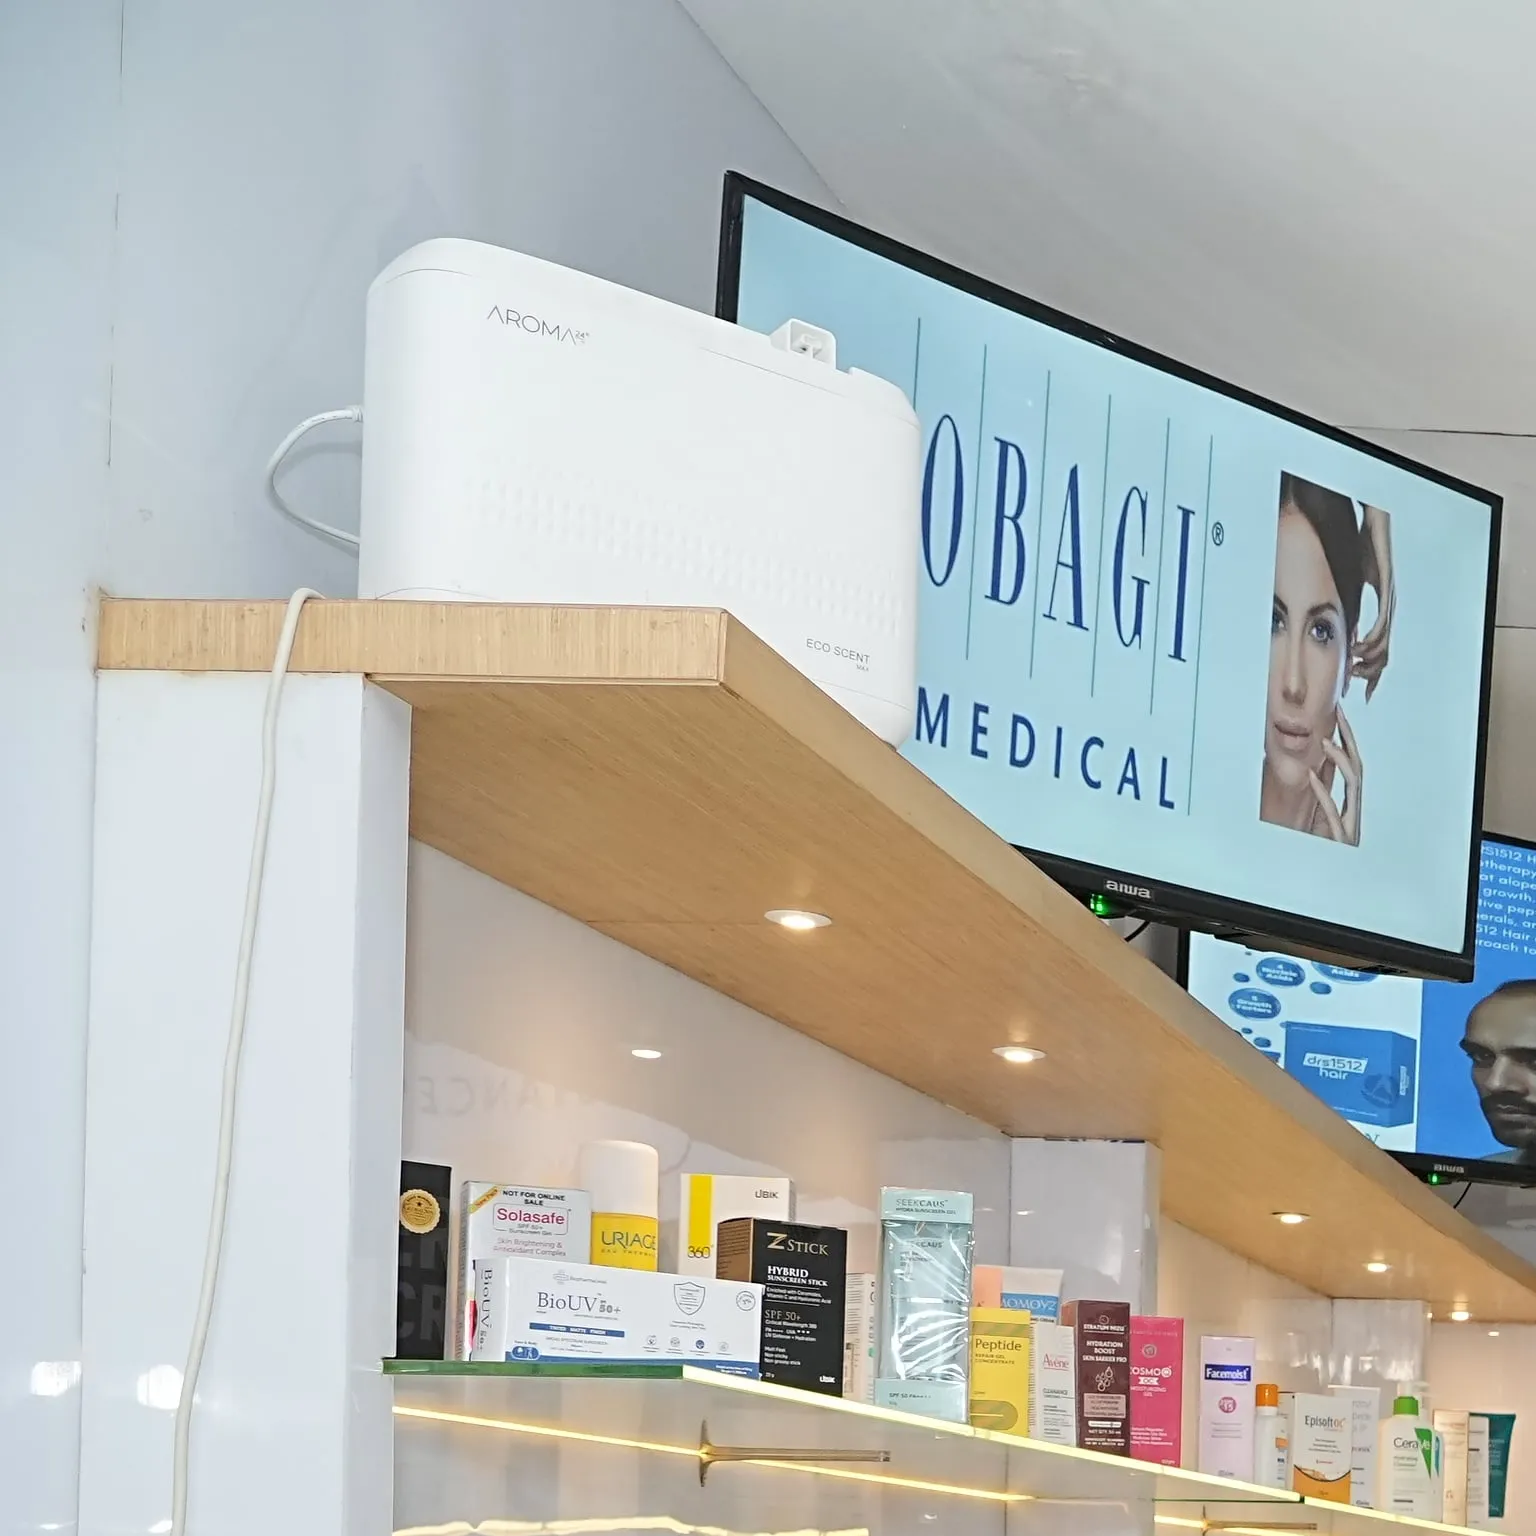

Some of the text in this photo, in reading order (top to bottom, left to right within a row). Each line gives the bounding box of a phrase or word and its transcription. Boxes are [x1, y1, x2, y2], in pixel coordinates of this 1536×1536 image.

[921, 415, 1195, 661] OBAGI
[806, 639, 870, 664] ECO SCENT
[915, 687, 1175, 808] MEDICAL
[1503, 929, 1530, 940] Hair
[1524, 945, 1536, 955] to
[1307, 1055, 1364, 1072] drs1512
[1319, 1068, 1348, 1080] hair
[497, 1208, 564, 1224] Solasafe
[514, 1239, 554, 1249] Brightening
[787, 1240, 828, 1256] STICK
[768, 1266, 808, 1278] HYBRID
[768, 1275, 807, 1284] SUNSCREEN
[480, 1270, 492, 1328] BioUV
[537, 1292, 621, 1313] BioUV 50+
[765, 1310, 800, 1320] SPF 50+
[976, 1339, 1022, 1352] Peptide
[1206, 1368, 1247, 1379] Facemoist
